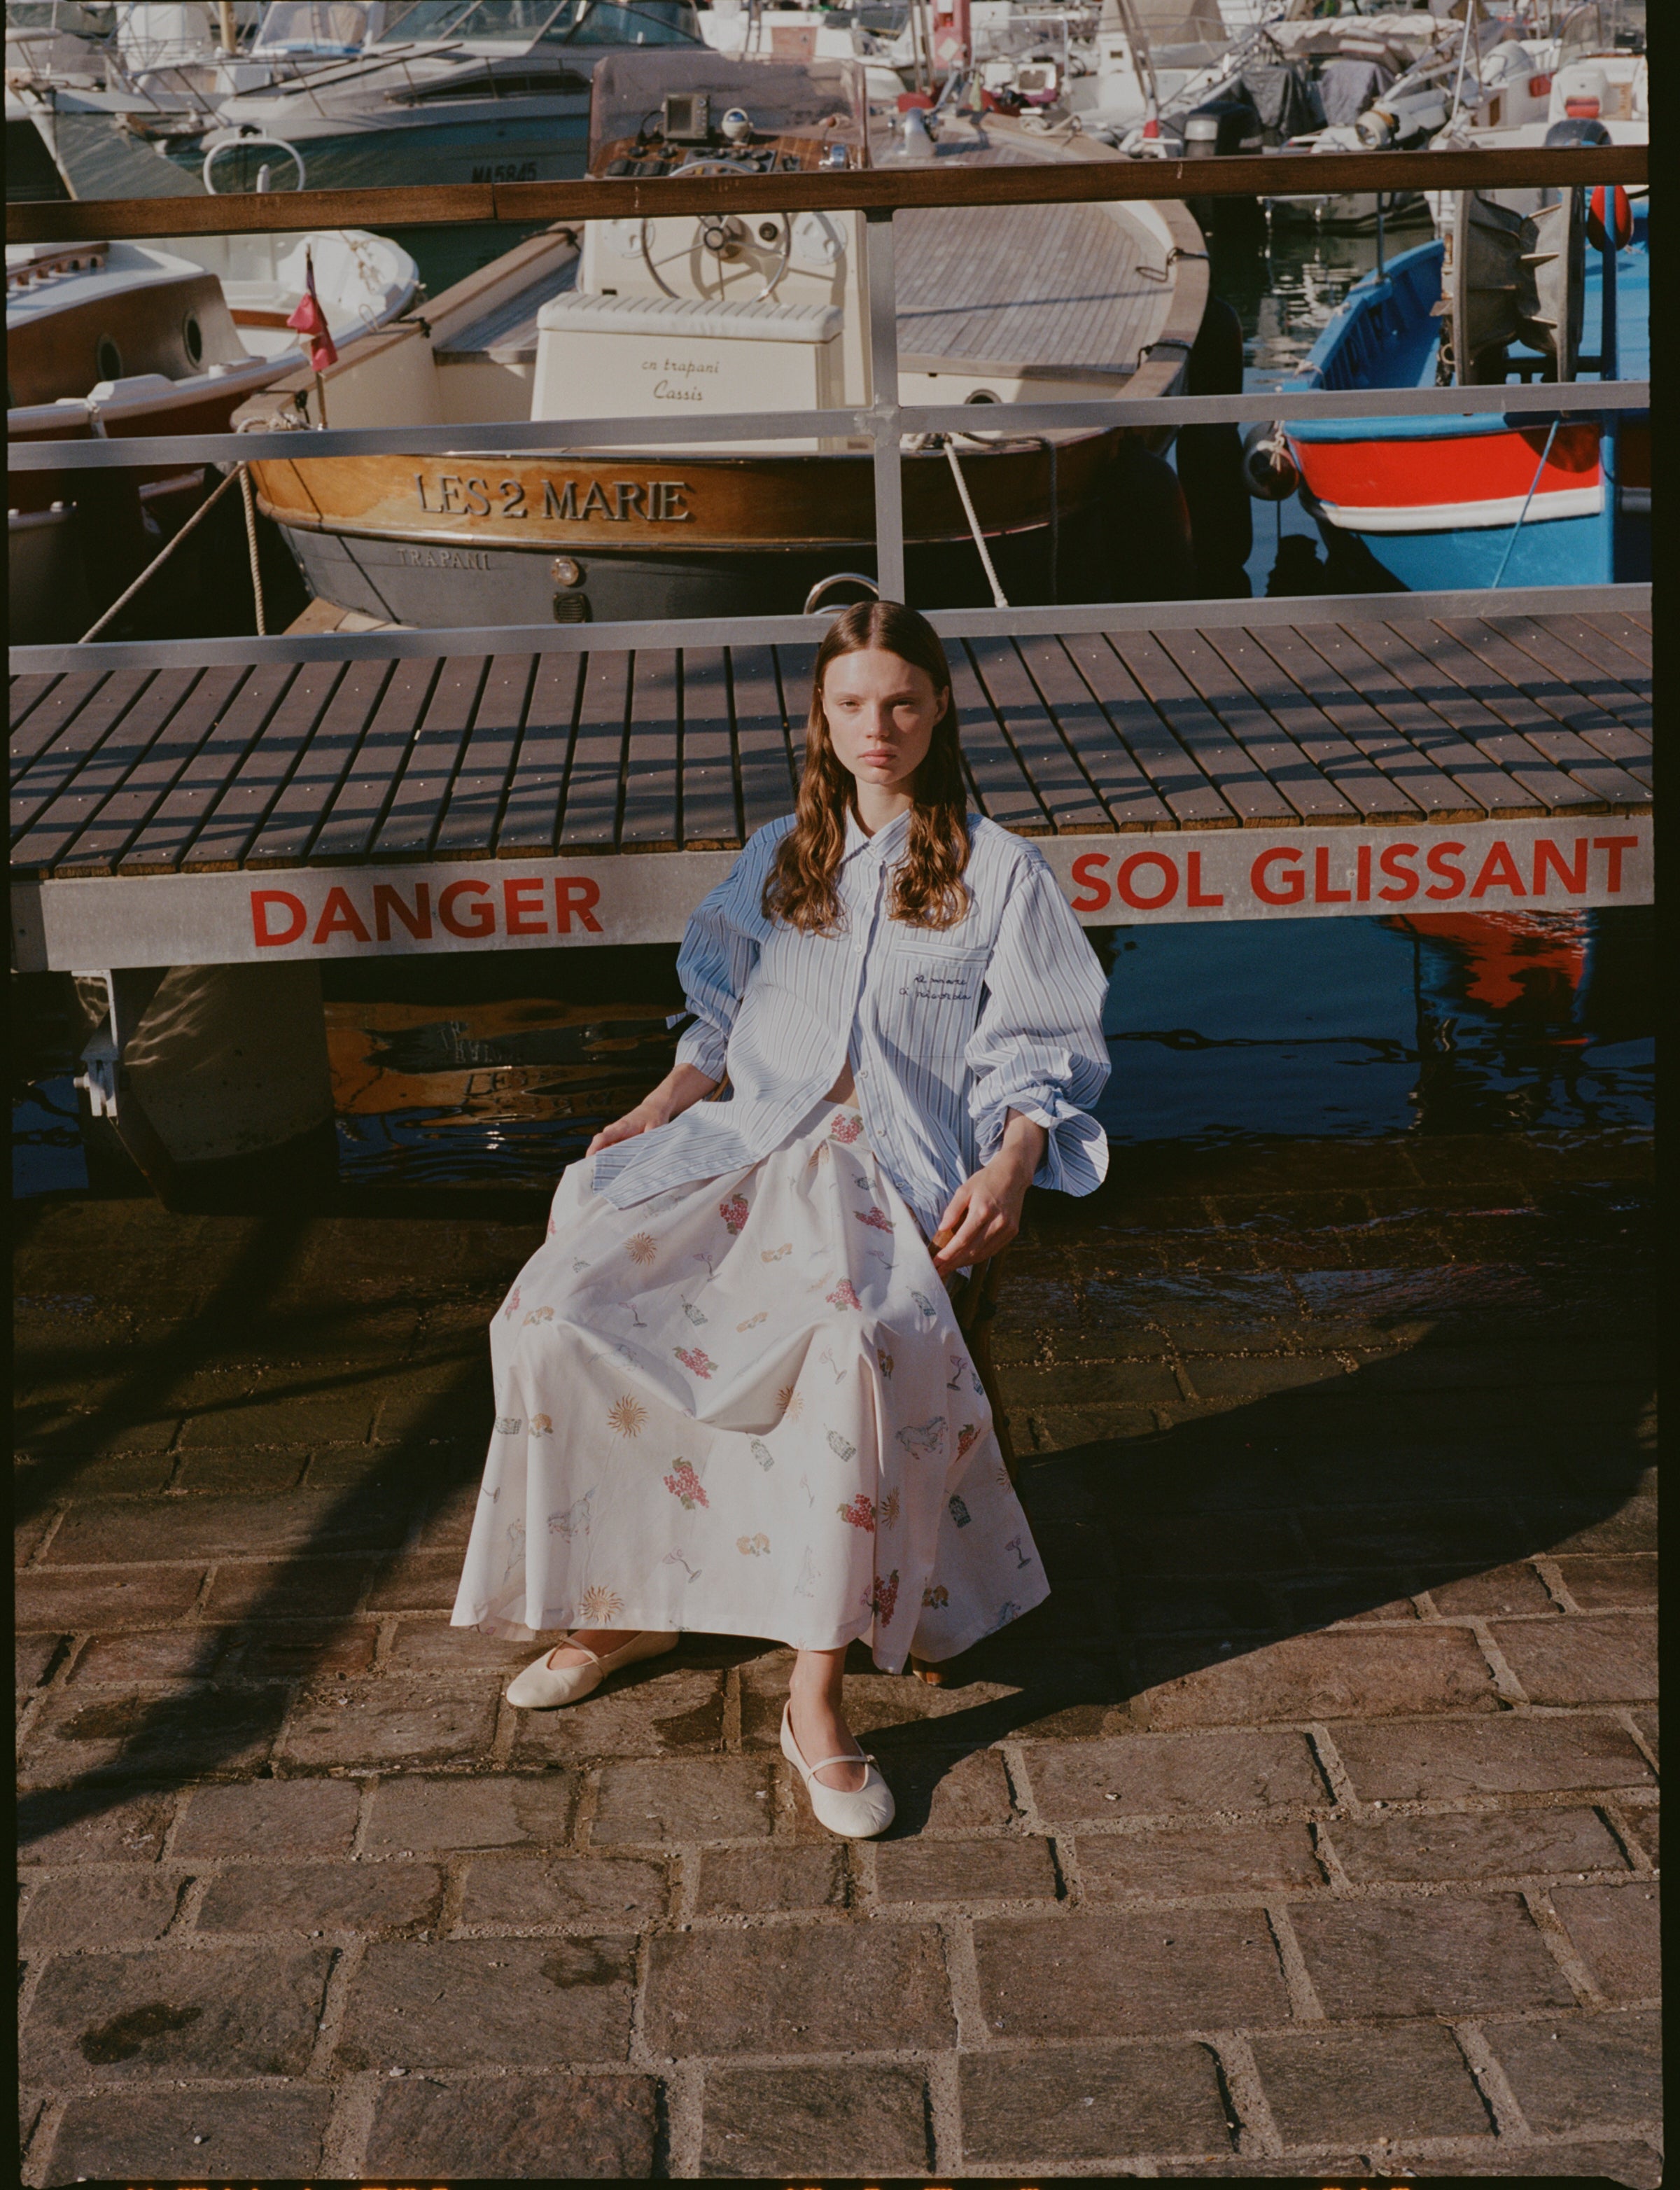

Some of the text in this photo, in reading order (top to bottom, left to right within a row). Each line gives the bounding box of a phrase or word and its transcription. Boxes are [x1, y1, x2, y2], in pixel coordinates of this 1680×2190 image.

[664, 358, 720, 378] trapani
[653, 379, 703, 400] Cassis
[413, 473, 690, 522] LES 2 MARIE
[397, 548, 491, 571] TRAPANI
[250, 835, 1639, 948] DANGER SOL GLISSANT
